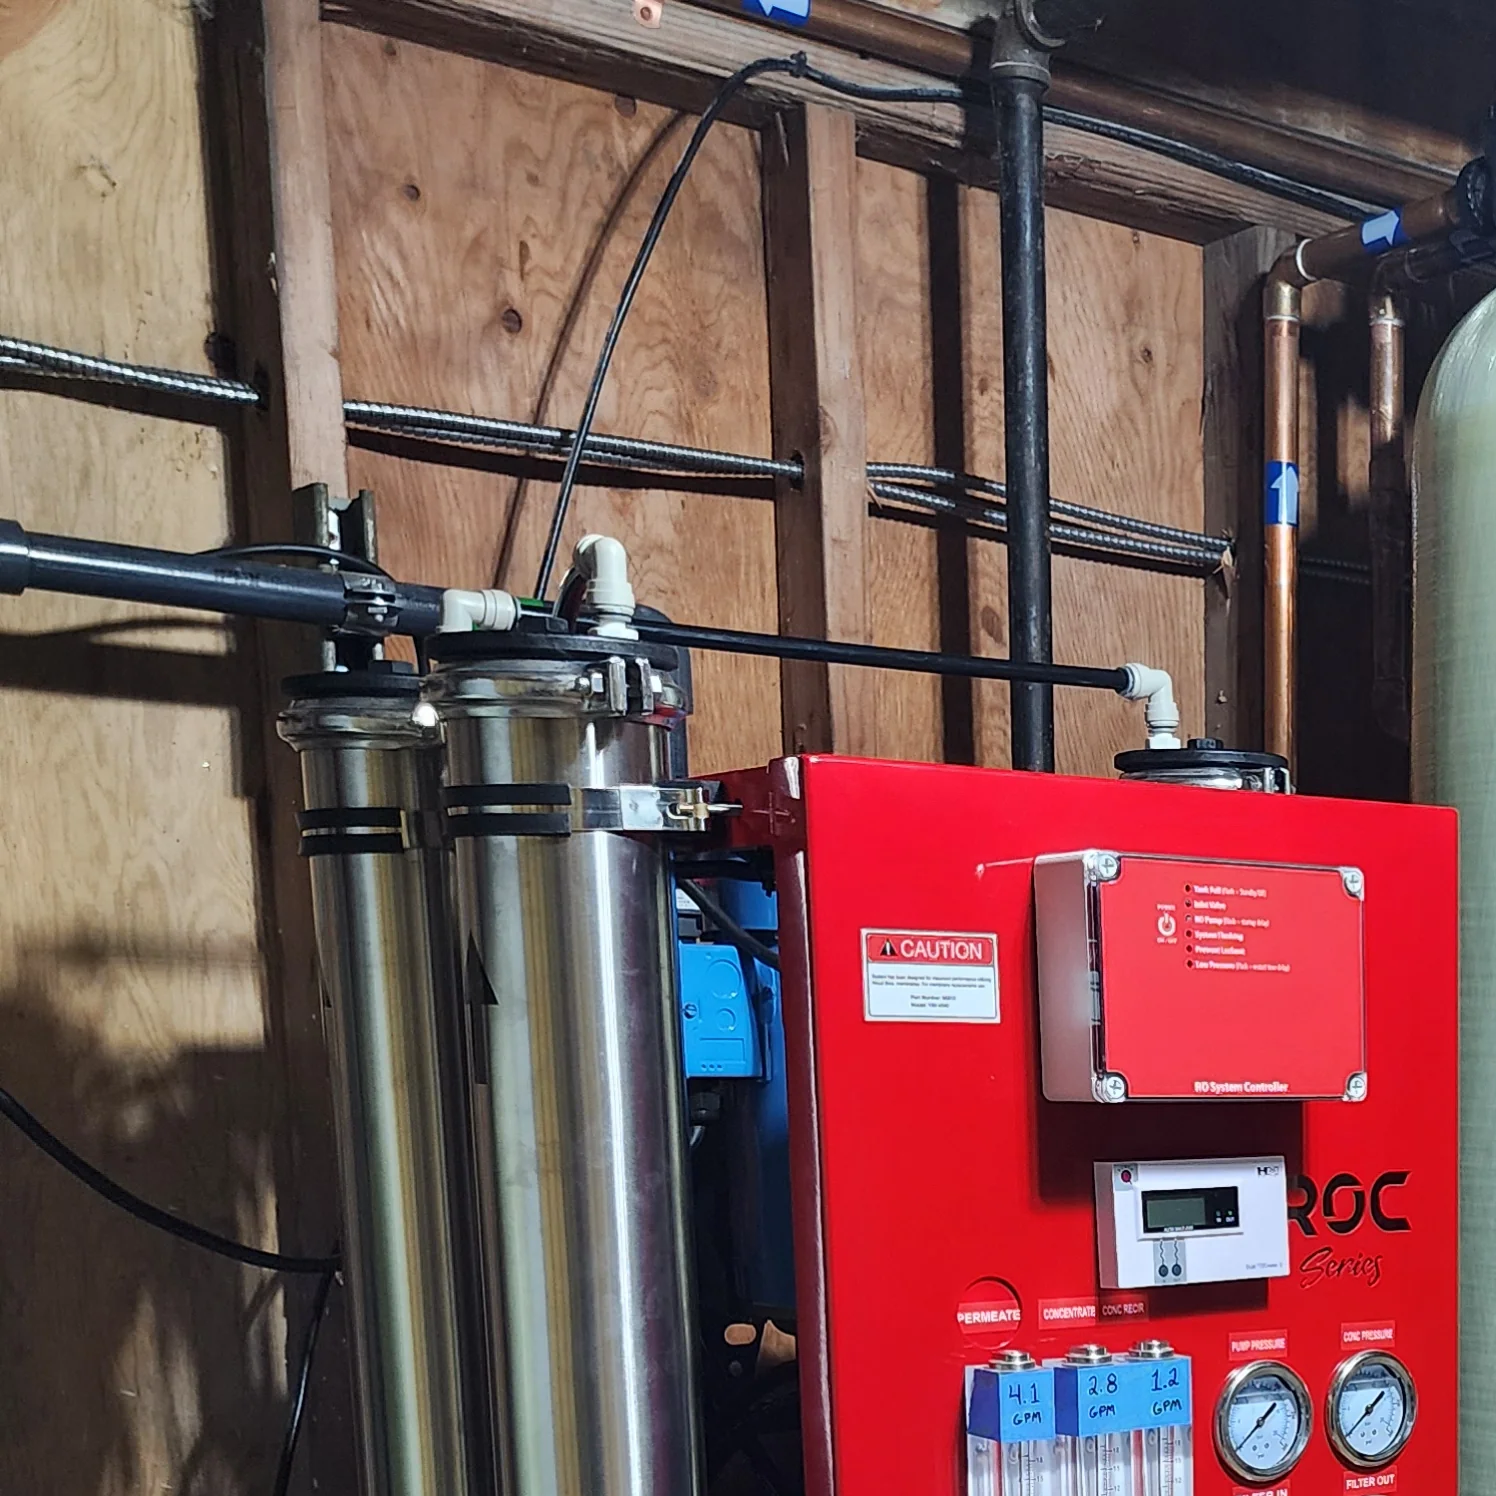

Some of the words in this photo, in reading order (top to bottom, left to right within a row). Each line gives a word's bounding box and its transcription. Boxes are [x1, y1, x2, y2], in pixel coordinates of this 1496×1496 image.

[900, 939, 982, 960] CAUTION
[1194, 1081, 1209, 1093] RO
[1210, 1081, 1242, 1094] System
[1244, 1081, 1289, 1093] Controller
[1287, 1171, 1411, 1237] ROC
[1300, 1247, 1383, 1289] Series
[957, 1309, 1021, 1324] PERMEATE
[1043, 1305, 1095, 1320] CONCENTRATE
[1102, 1304, 1122, 1316] CONC
[1362, 1328, 1393, 1341] PRESSURE
[1251, 1338, 1285, 1350] PRESSURE
[1088, 1373, 1117, 1395] 2.8
[1151, 1368, 1179, 1391] 1.2
[1009, 1383, 1039, 1405] 4.1
[1089, 1405, 1115, 1419] GPM
[1153, 1399, 1182, 1415] GPM
[1013, 1411, 1041, 1425] GPM
[1346, 1476, 1375, 1489] FILTER
[1377, 1474, 1394, 1485] OUT
